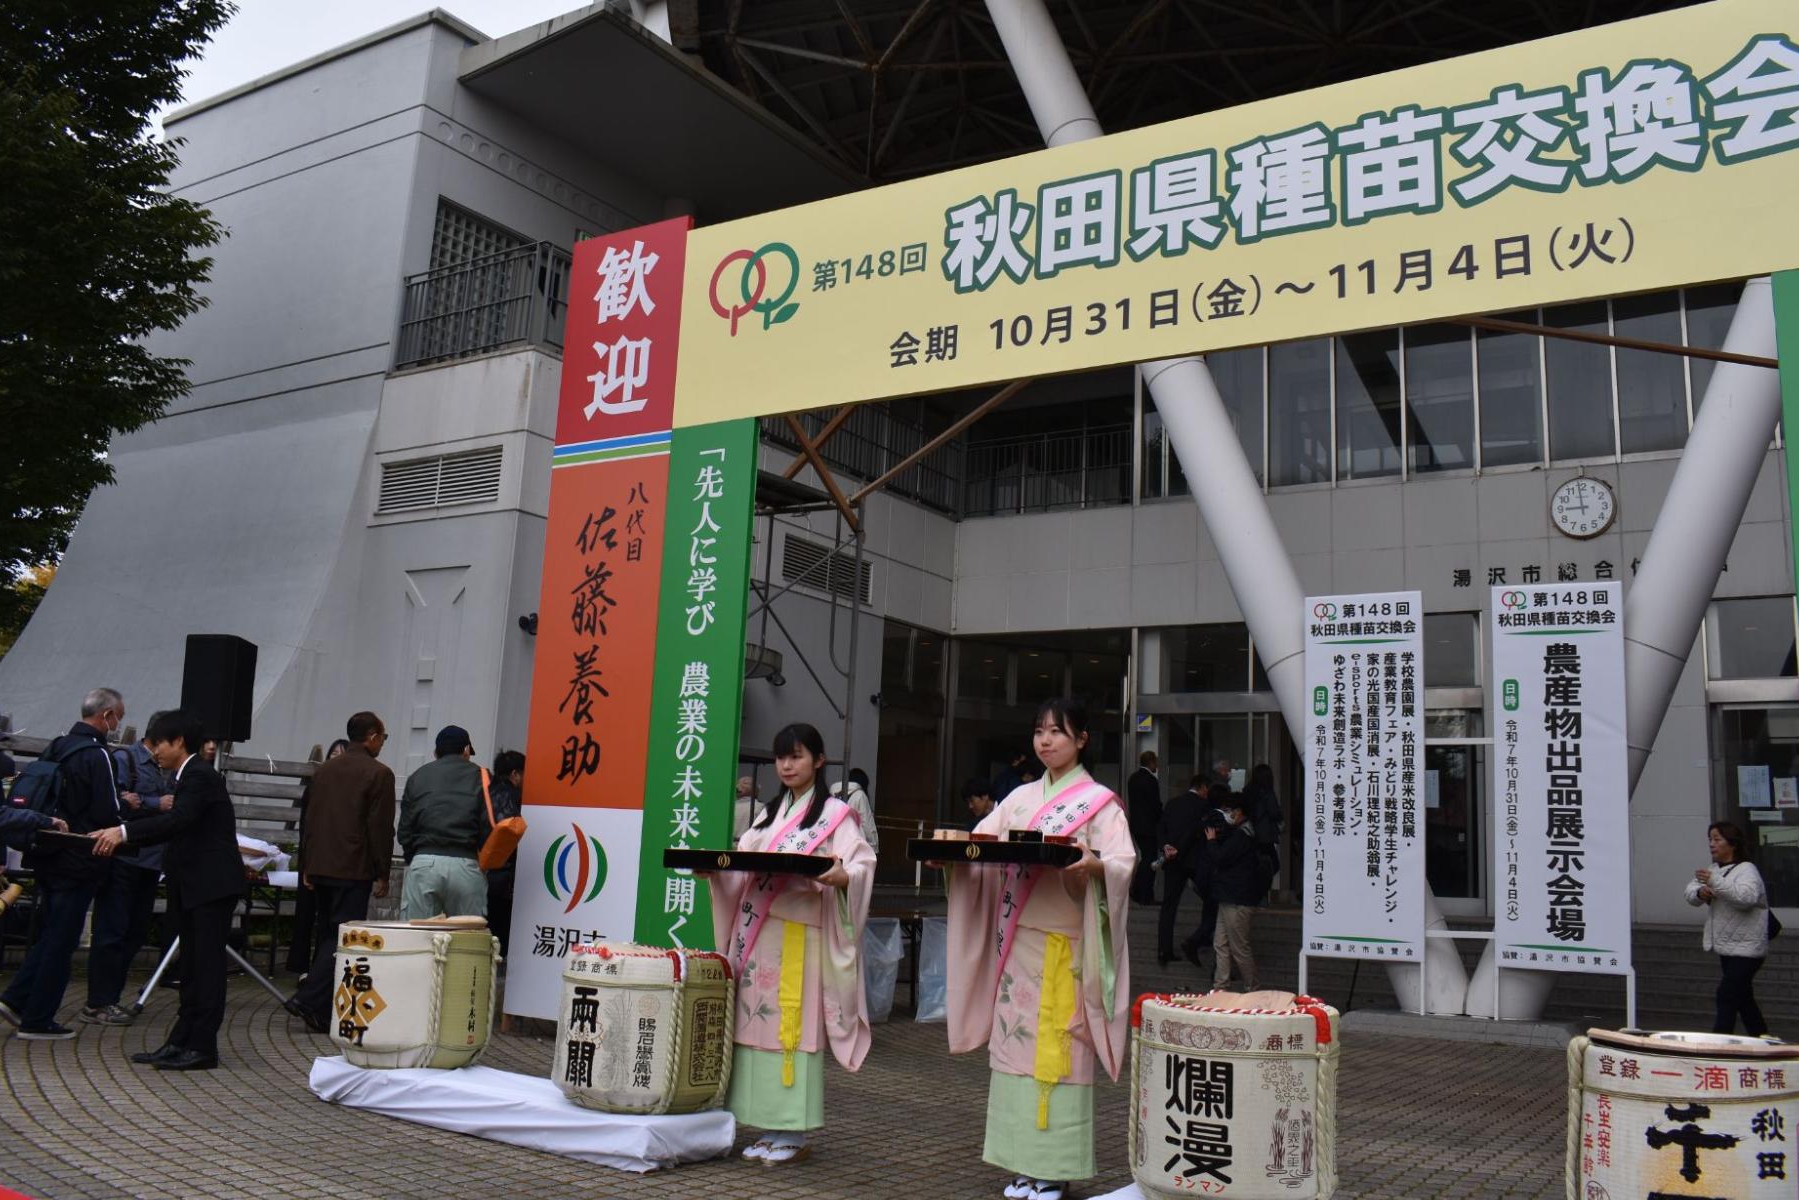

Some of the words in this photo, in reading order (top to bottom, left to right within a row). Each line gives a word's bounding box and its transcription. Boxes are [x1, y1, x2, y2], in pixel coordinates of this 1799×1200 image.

[941, 34, 1799, 295] 秋田県種苗交換会
[812, 243, 927, 292] 第148回
[583, 240, 660, 421] 歓迎
[889, 323, 960, 369] 会期
[626, 482, 649, 562] 八代目
[685, 447, 726, 636] 「先人に学び
[1310, 620, 1416, 637] 秋田県種苗交換会
[1342, 601, 1410, 618] 第148回
[1498, 610, 1616, 628] 秋田県種苗交換会
[1533, 590, 1609, 608] 第148回
[556, 506, 618, 786] 佐藤養助
[1315, 690, 1327, 712] 日時
[1505, 683, 1516, 706] 日時
[664, 660, 711, 949] 農業の未来開く
[1543, 642, 1586, 942] 農産物出品展示会場
[338, 957, 374, 1047] 福小町
[1737, 1066, 1786, 1090] 商標
[1164, 1053, 1234, 1185] 爛漫
[1751, 1107, 1786, 1180] 秋田
[1174, 1175, 1226, 1194] ランマン
